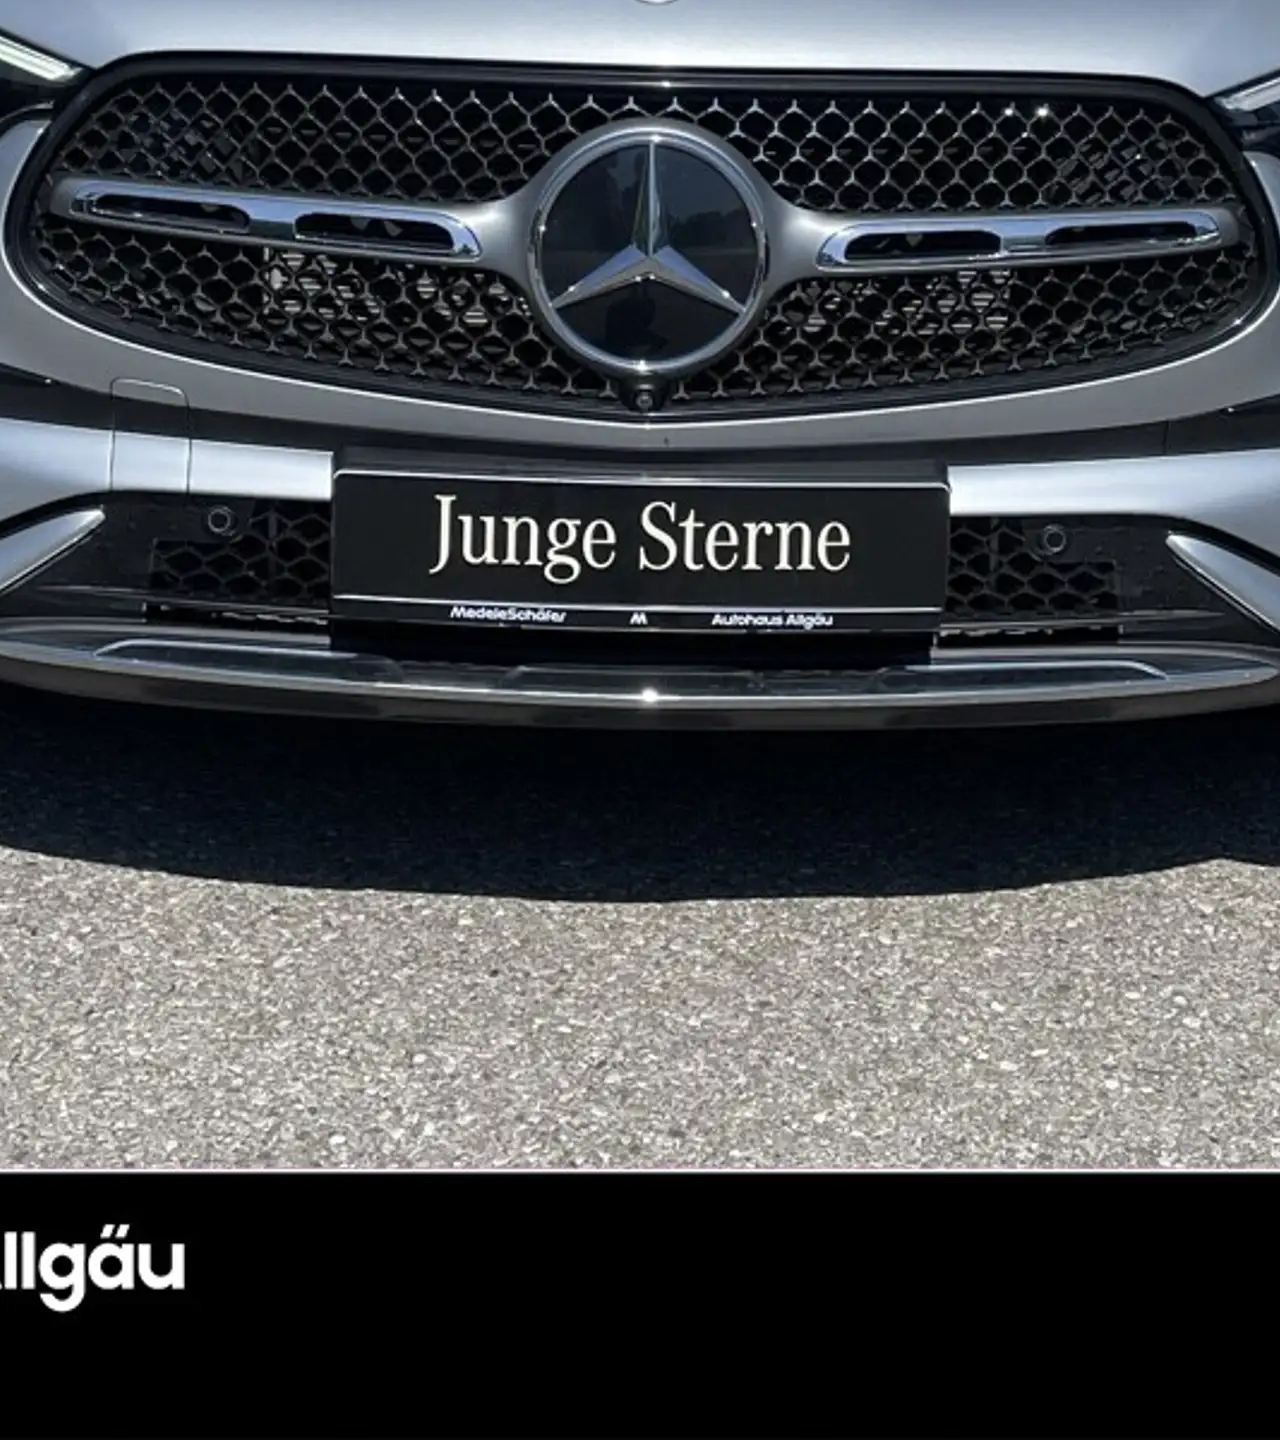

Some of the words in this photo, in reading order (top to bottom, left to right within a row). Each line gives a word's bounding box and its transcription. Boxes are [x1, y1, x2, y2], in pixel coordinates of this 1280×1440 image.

[428, 494, 618, 585] Junge
[639, 501, 851, 572] Sterne
[449, 605, 568, 624] MedeleSchäfer
[711, 613, 783, 627] Autohaus
[785, 612, 834, 631] Allgäu
